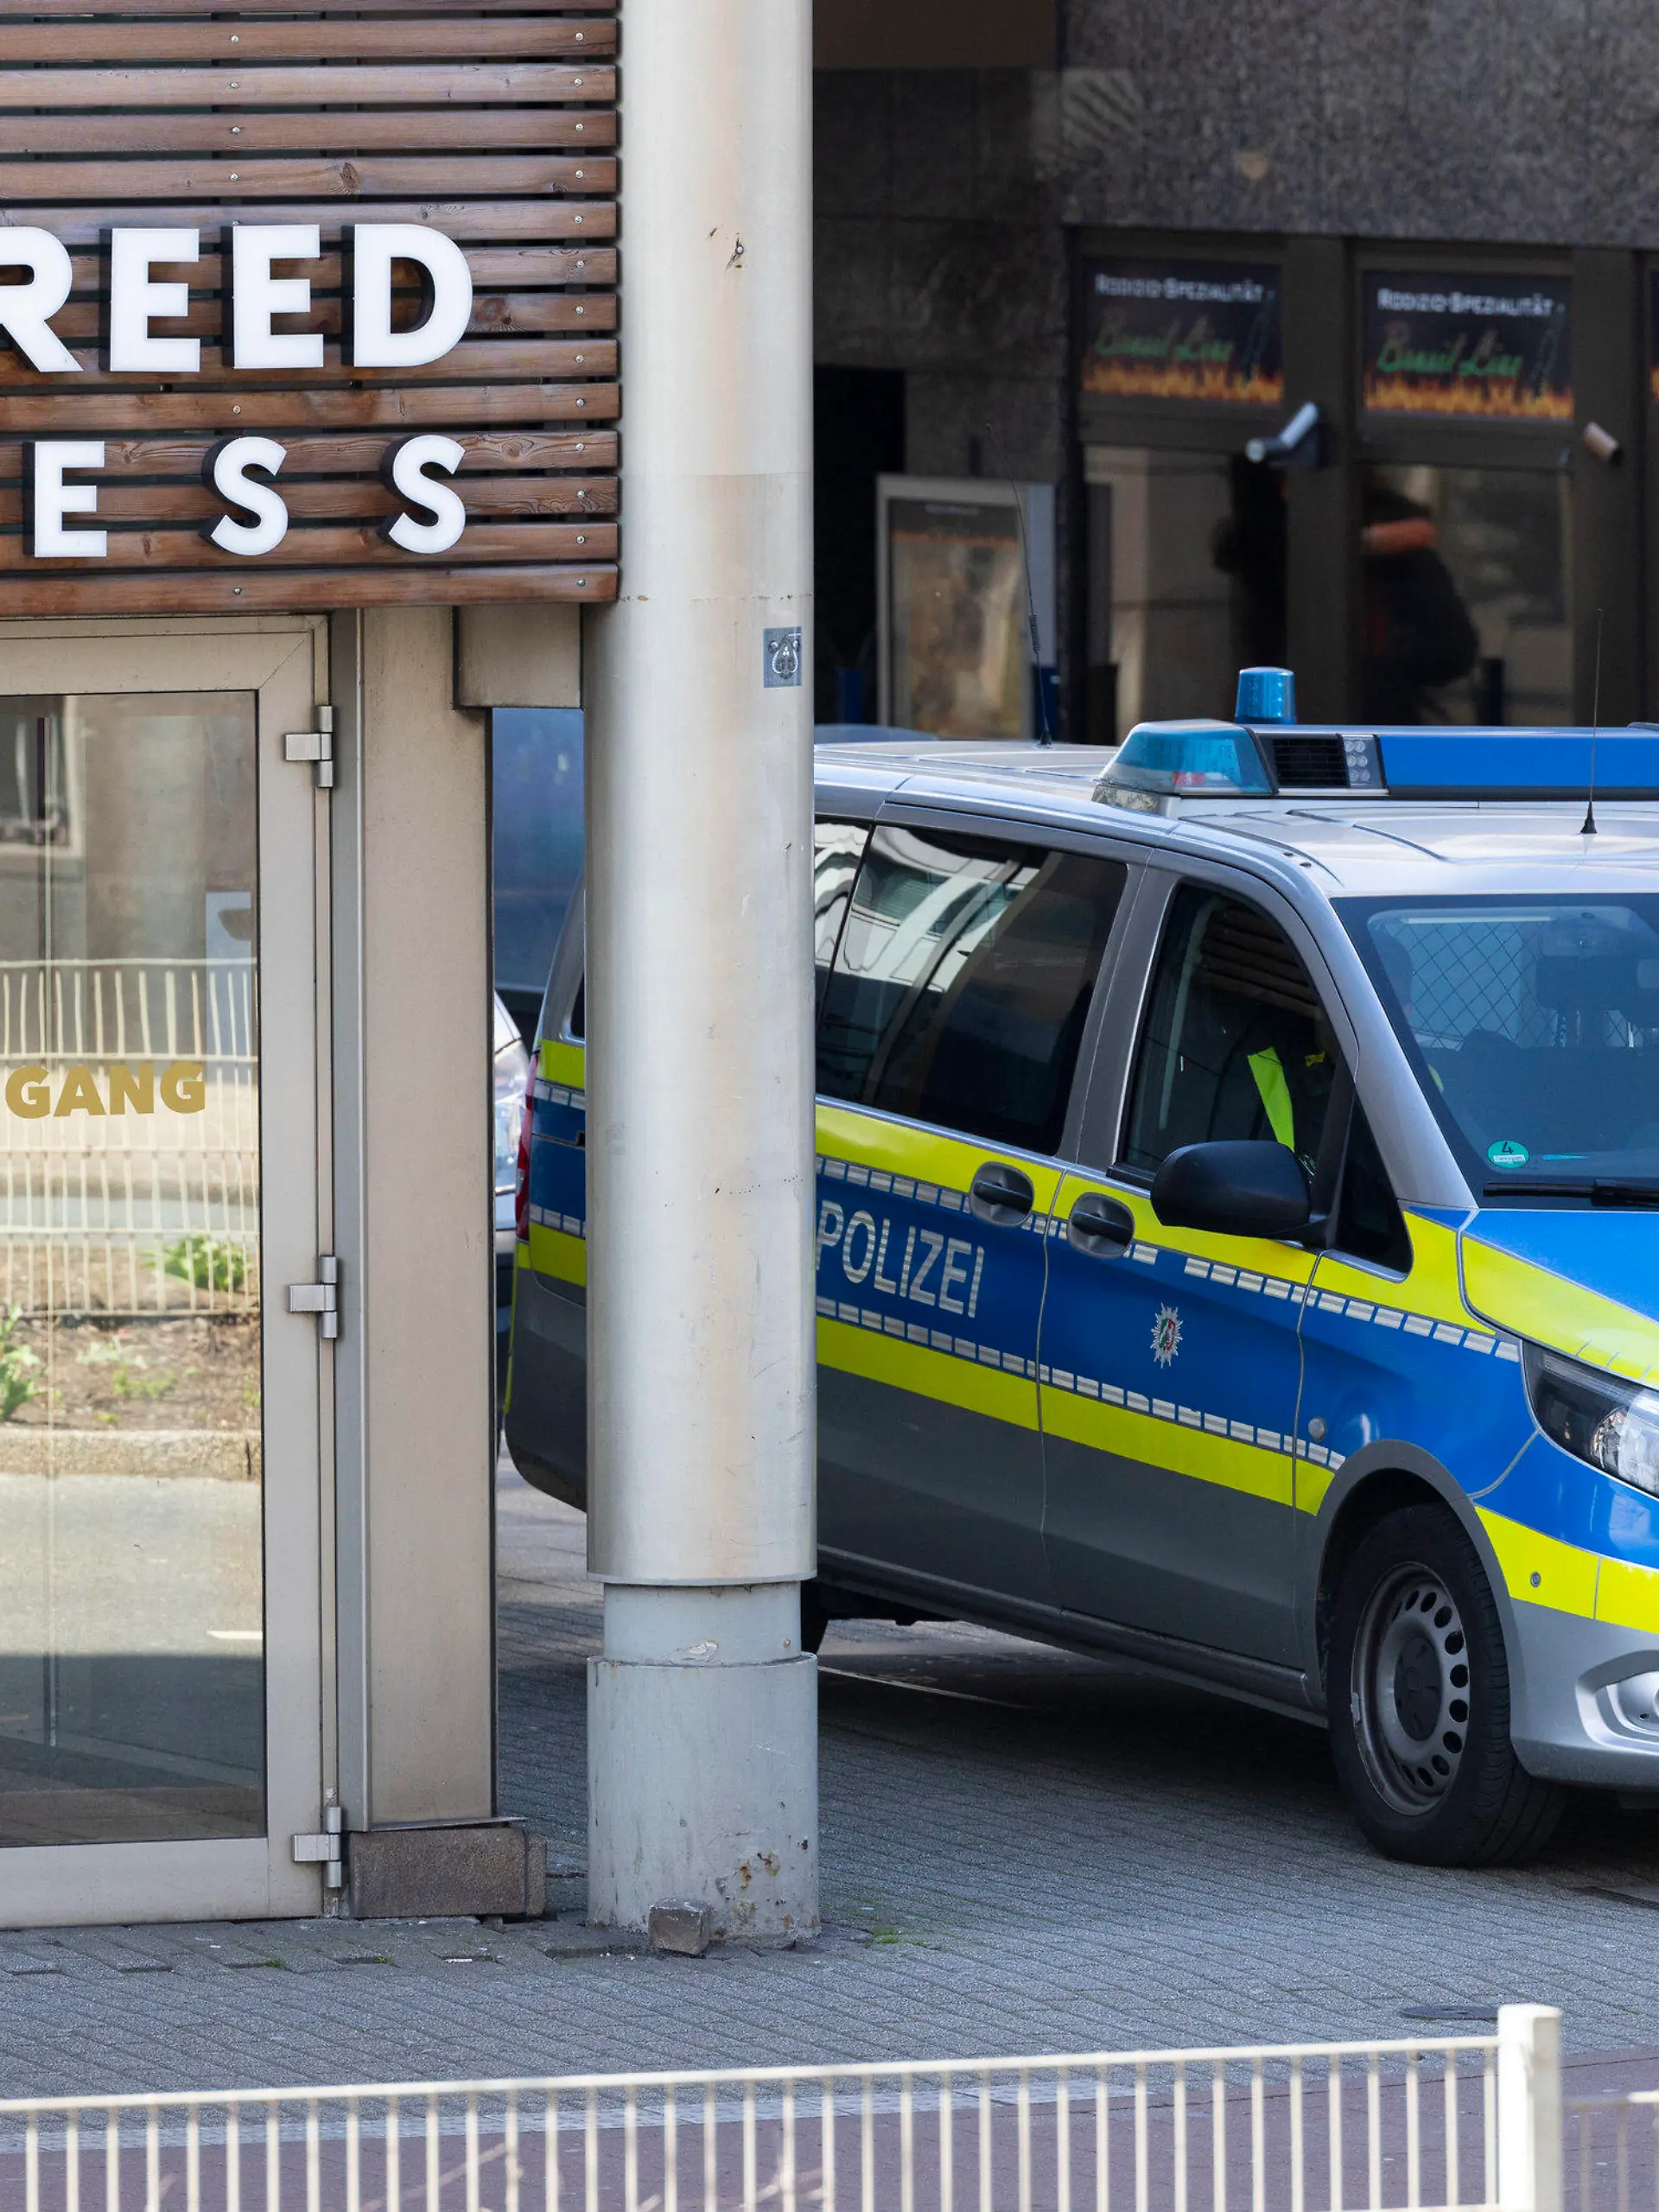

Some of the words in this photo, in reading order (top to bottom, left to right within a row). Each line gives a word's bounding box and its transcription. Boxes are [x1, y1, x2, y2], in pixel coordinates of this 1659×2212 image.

[0, 224, 473, 372] REED
[5, 1060, 207, 1120] GANG
[1501, 1141, 1514, 1154] 4
[816, 1199, 985, 1319] POLIZEI
